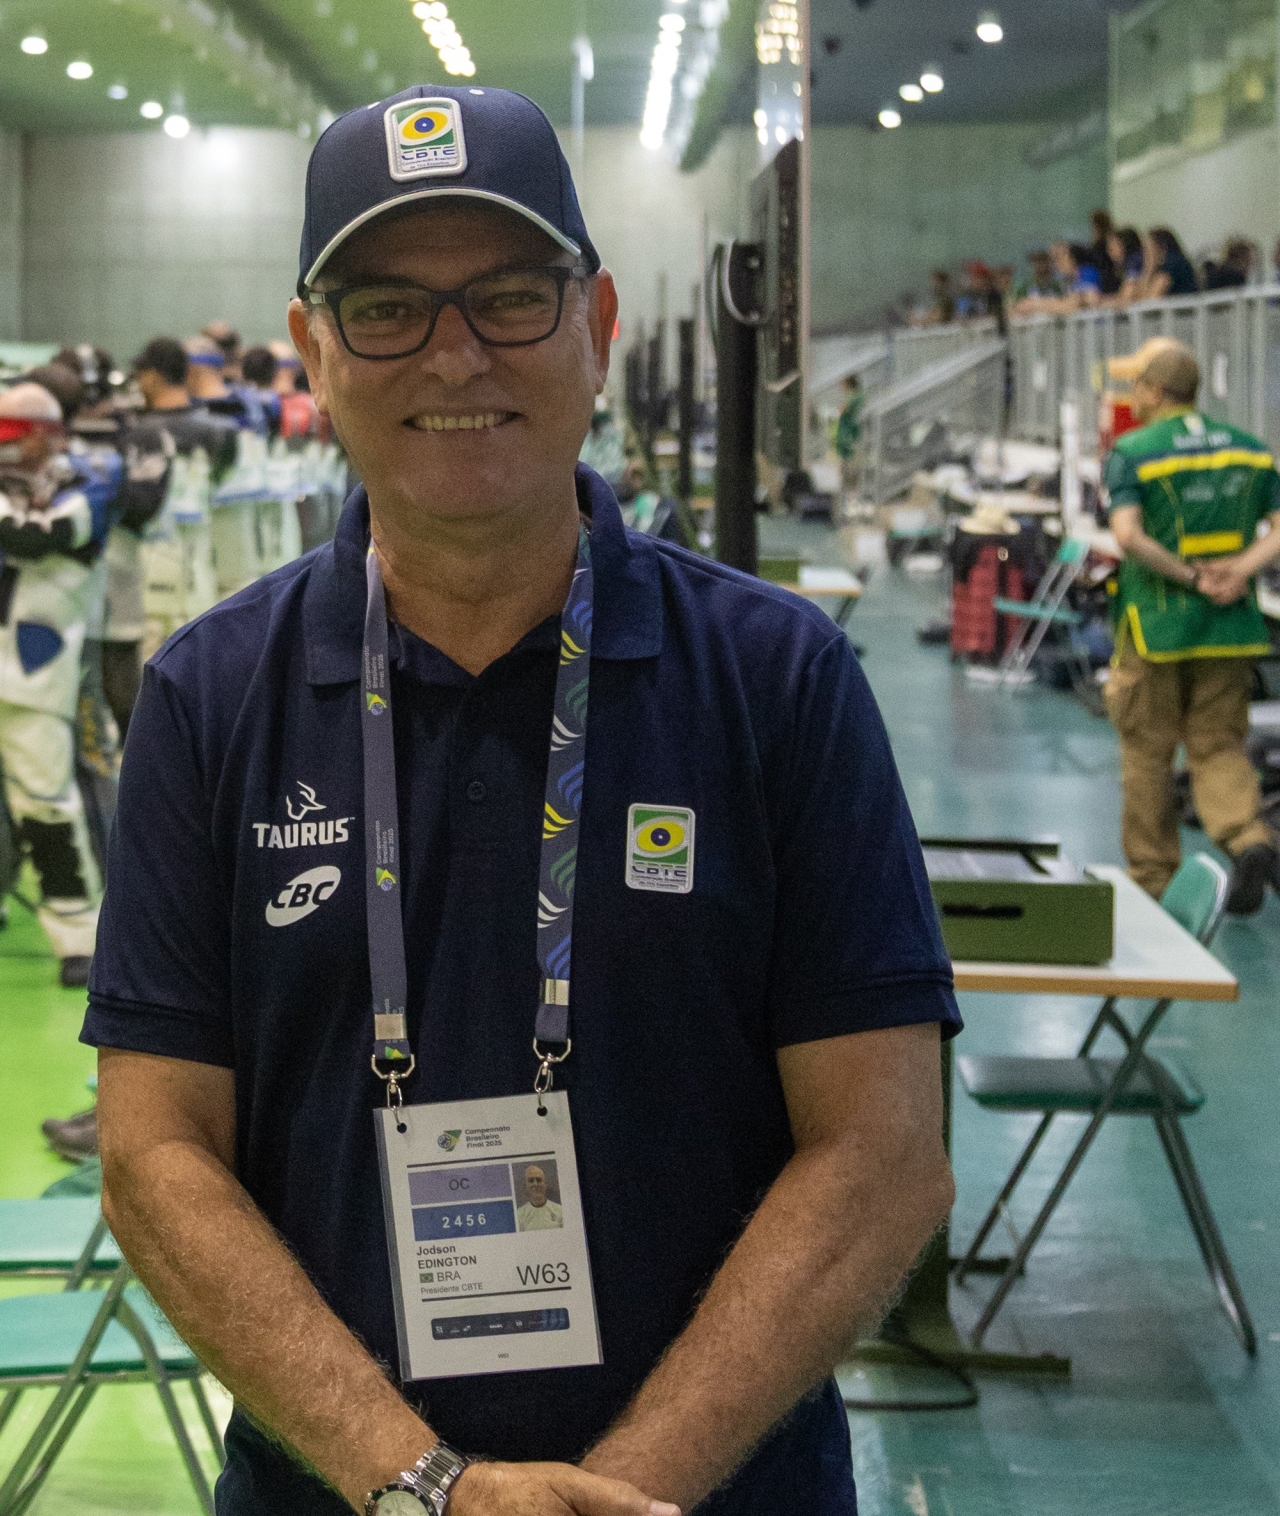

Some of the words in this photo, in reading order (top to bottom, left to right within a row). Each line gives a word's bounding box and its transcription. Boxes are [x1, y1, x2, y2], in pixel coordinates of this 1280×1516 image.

[252, 817, 349, 849] TAURUS
[271, 881, 335, 909] CBC
[465, 1126, 510, 1135] Campeonato
[466, 1134, 499, 1142] Brasileiro
[449, 1178, 470, 1191] OC
[417, 1245, 456, 1256] Jodson
[418, 1255, 477, 1269] EDINGTON
[437, 1270, 461, 1282] BRA
[516, 1262, 570, 1286] W63
[421, 1286, 460, 1295] Presidente
[461, 1282, 484, 1292] CBTE
